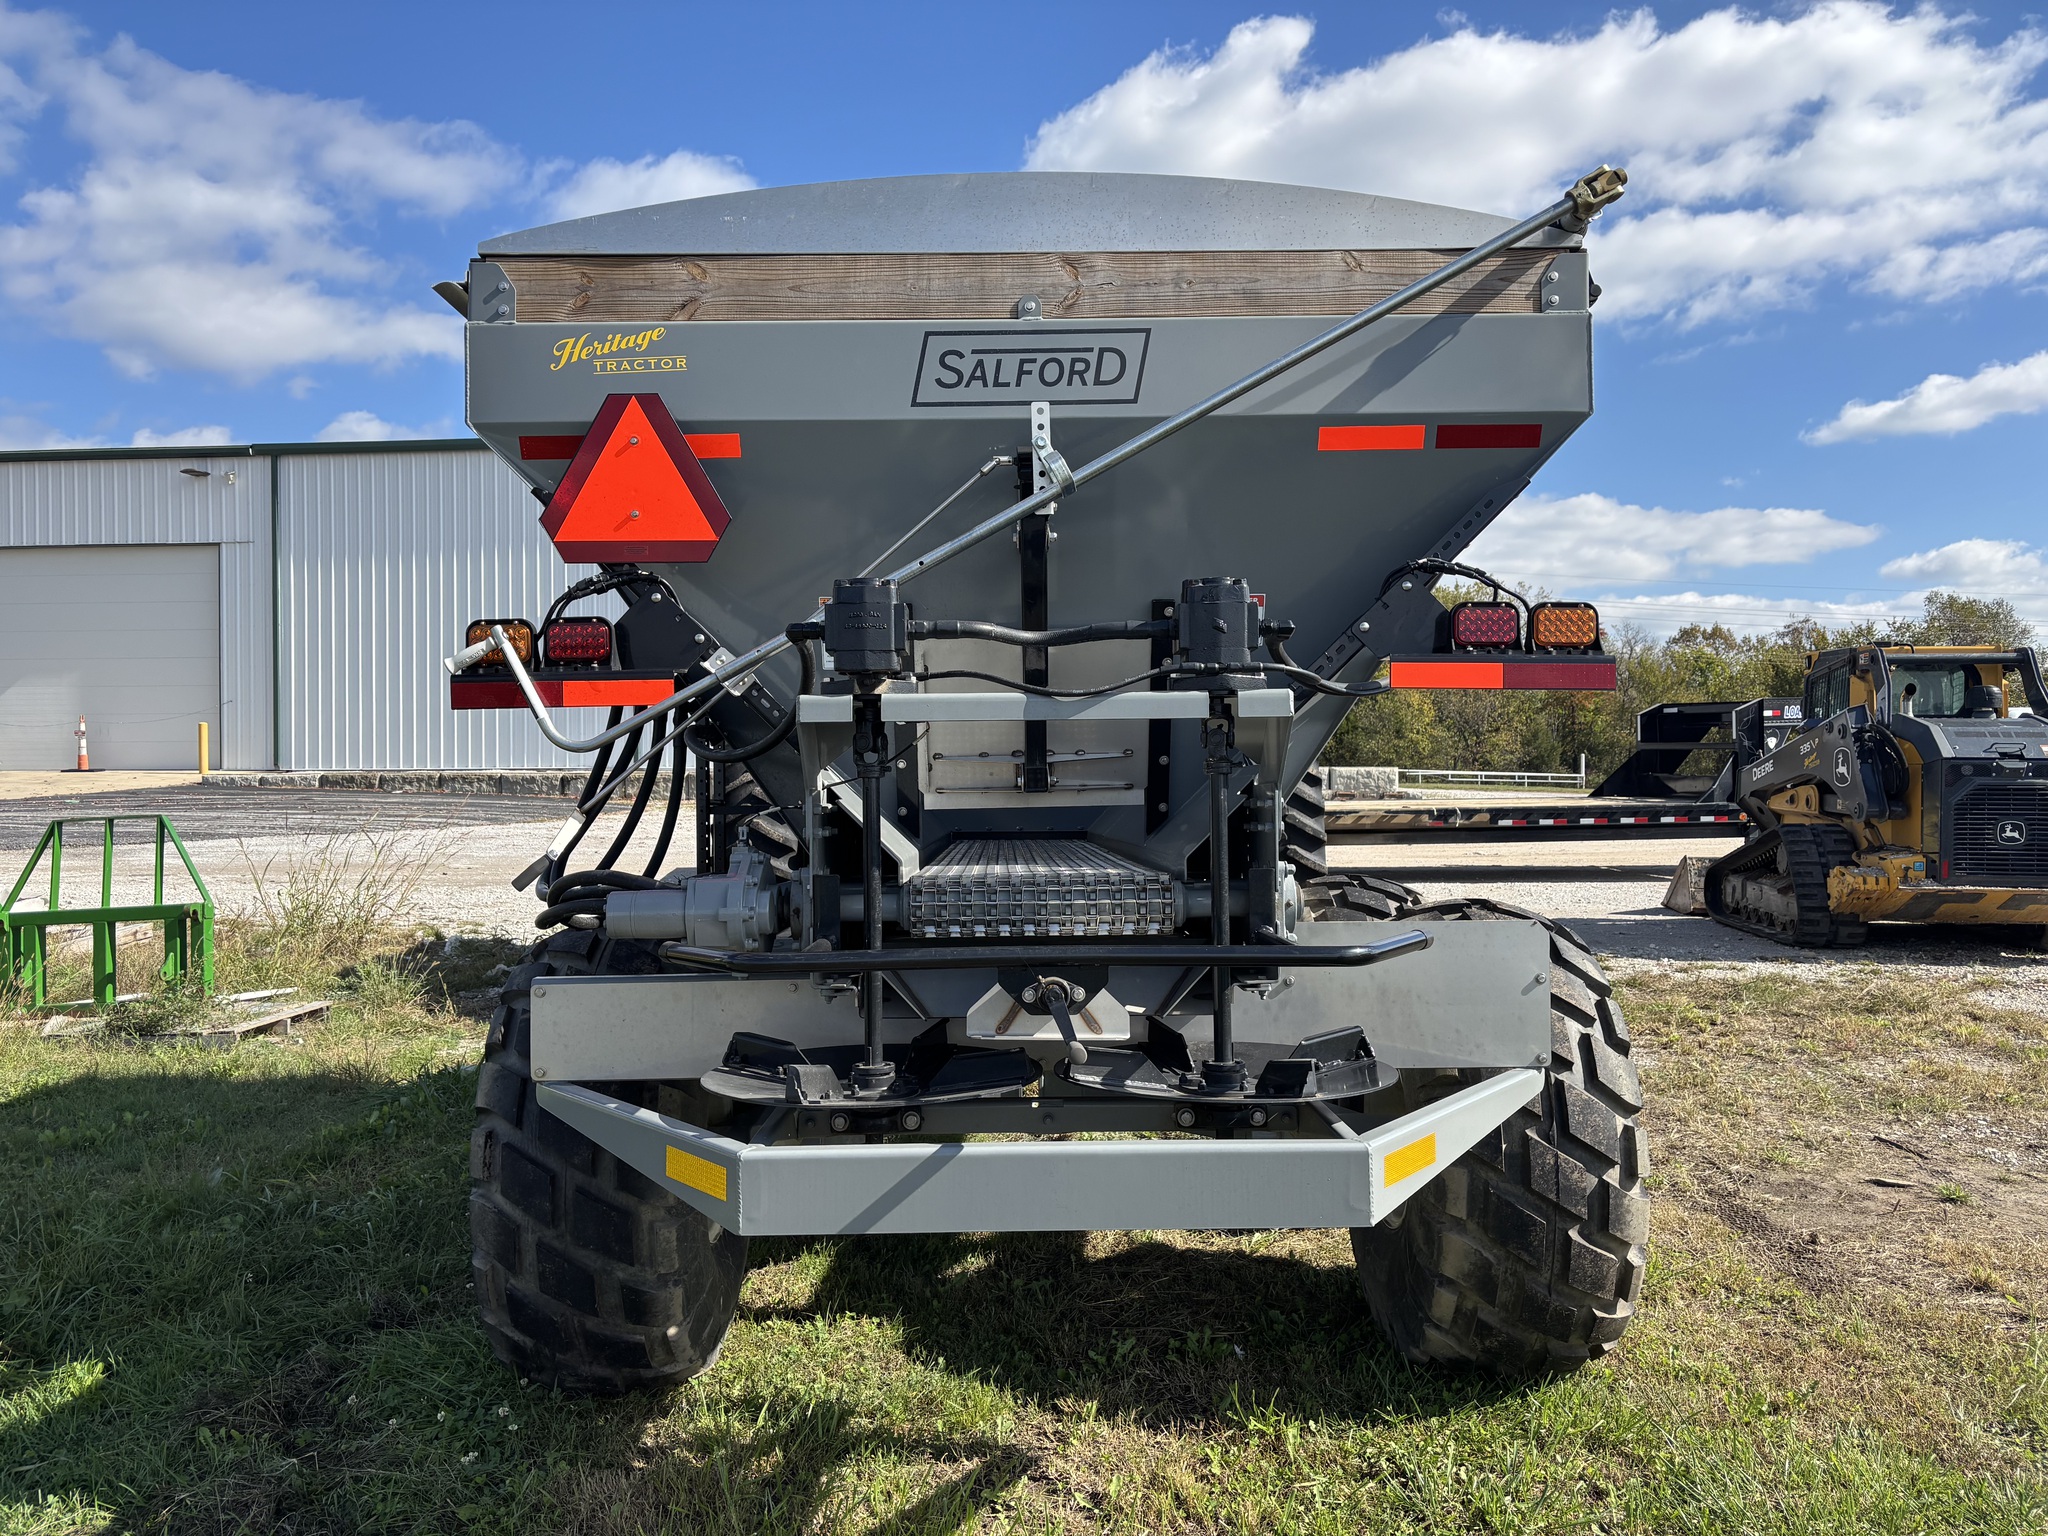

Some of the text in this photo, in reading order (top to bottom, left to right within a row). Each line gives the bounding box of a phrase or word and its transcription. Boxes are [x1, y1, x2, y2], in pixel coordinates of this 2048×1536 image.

[550, 327, 666, 371] Heritage
[593, 358, 687, 372] TRACTOR
[934, 346, 1127, 389] SALFORD
[1752, 759, 1774, 782] DEERE
